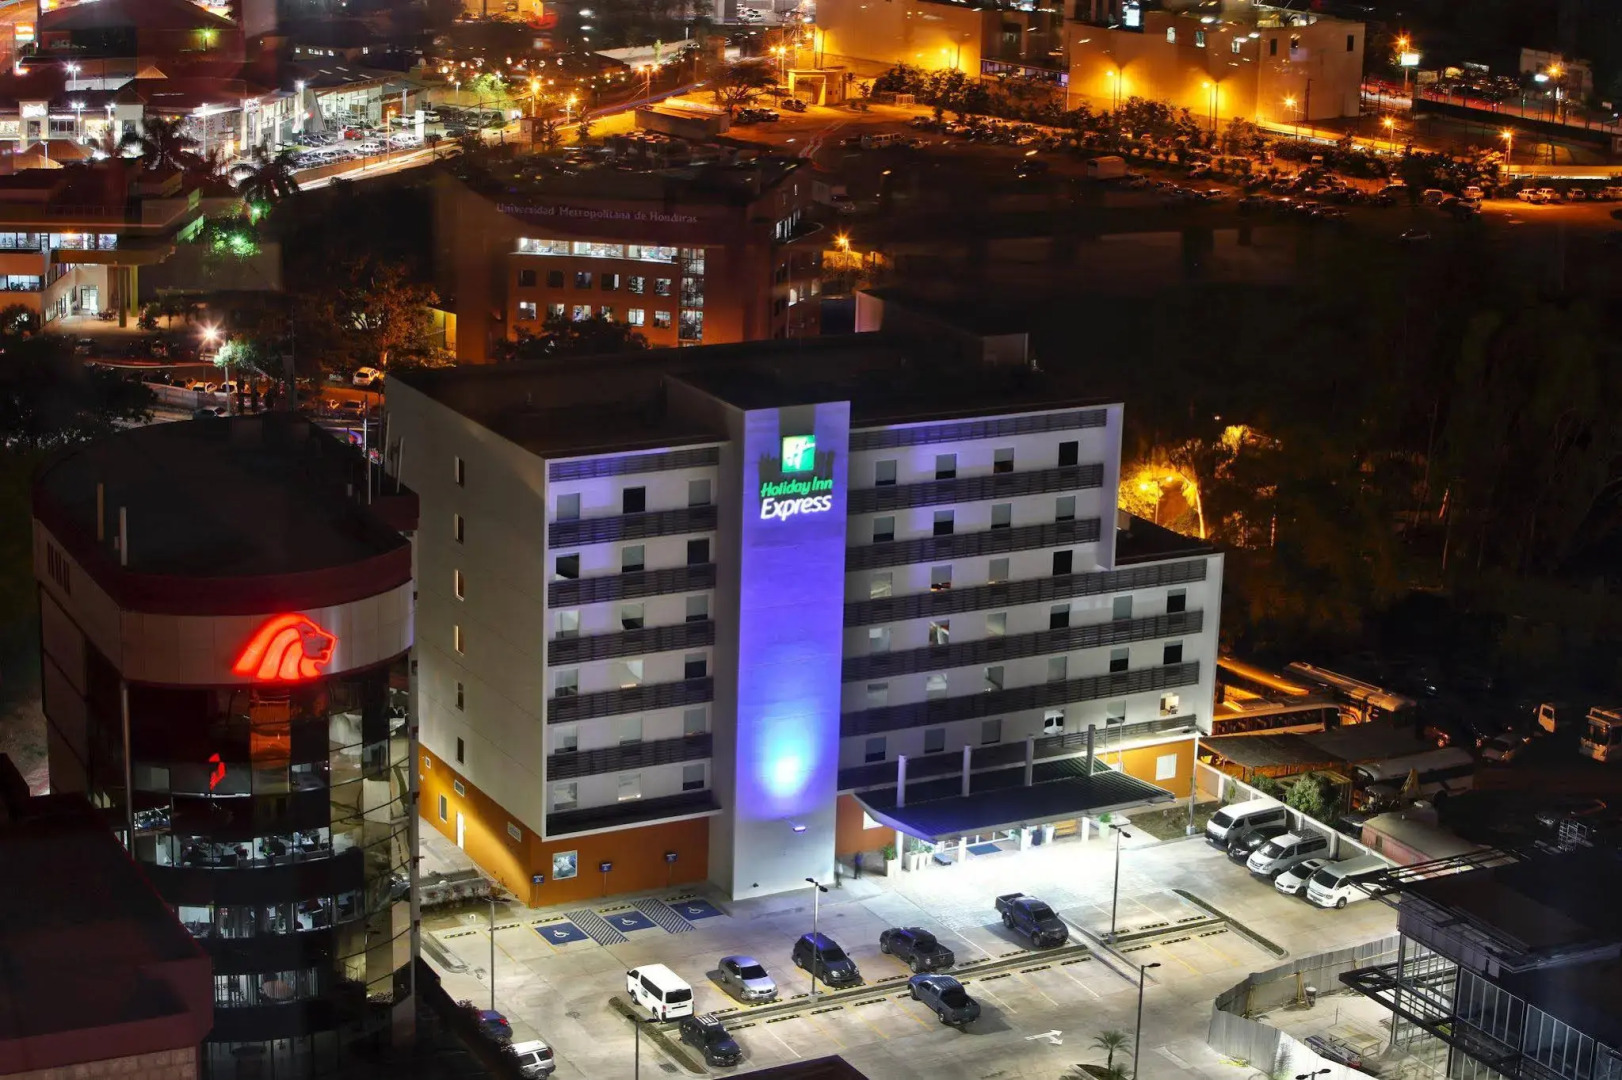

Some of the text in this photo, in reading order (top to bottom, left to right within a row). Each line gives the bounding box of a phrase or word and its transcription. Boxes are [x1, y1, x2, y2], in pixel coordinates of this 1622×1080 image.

[496, 203, 698, 223] Universidad Metropolitana de Honduras
[761, 476, 833, 497] Holiday Inn
[760, 494, 832, 521] Express
